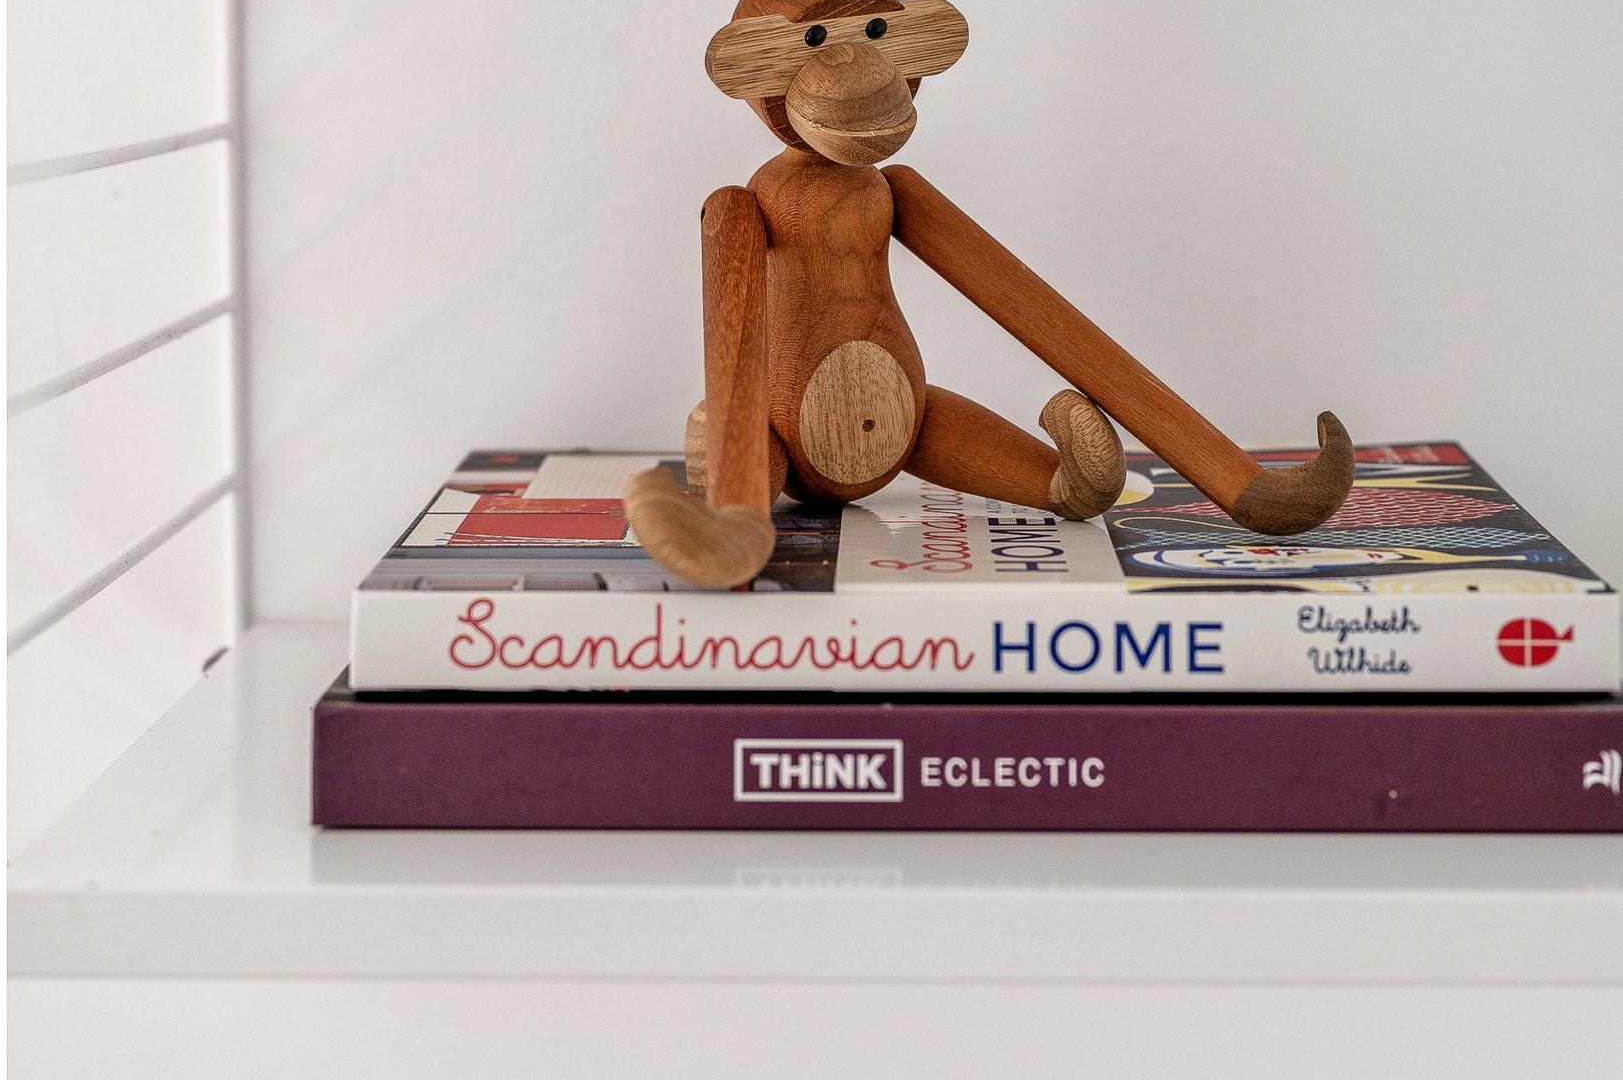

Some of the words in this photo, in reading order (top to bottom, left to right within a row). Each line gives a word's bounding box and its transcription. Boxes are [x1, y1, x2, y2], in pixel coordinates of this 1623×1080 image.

[869, 482, 974, 573] Scandina
[987, 517, 1069, 572] HOME
[448, 597, 975, 672] Scandinavian
[993, 621, 1225, 674] HOME
[1297, 605, 1421, 643] Elizabeth
[920, 756, 1106, 788] ECLECTIC
